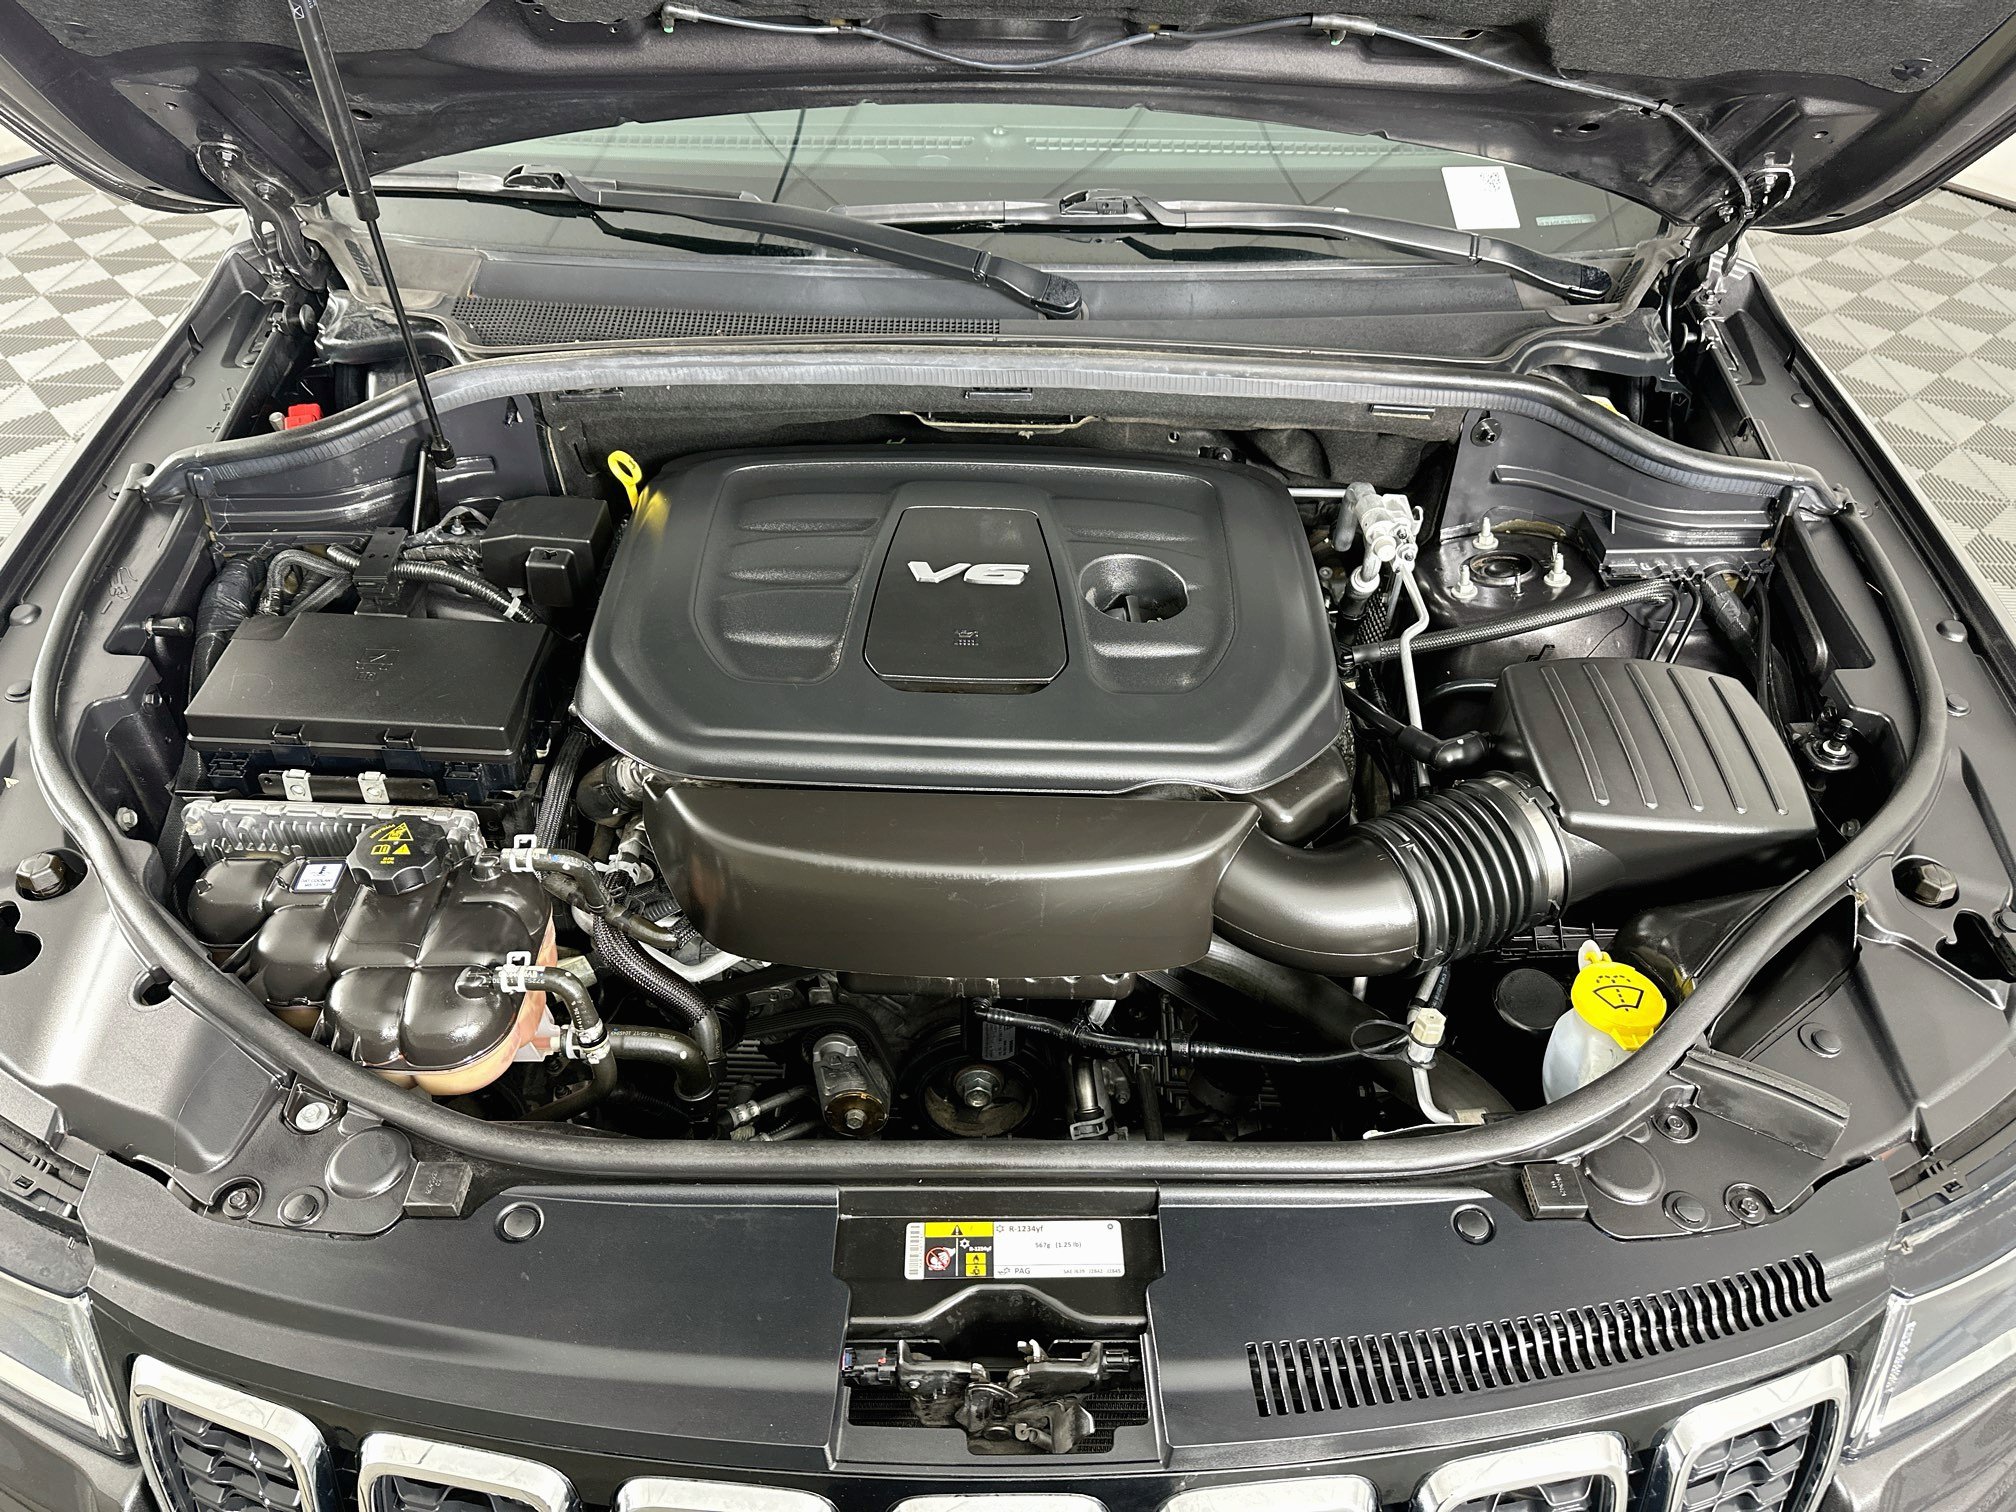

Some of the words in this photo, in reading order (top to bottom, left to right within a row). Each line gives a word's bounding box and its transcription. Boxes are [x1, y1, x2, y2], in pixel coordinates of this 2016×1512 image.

[907, 561, 1031, 585] V6
[1008, 1225, 1044, 1233] R-1234yf
[1014, 1267, 1031, 1275] PAG
